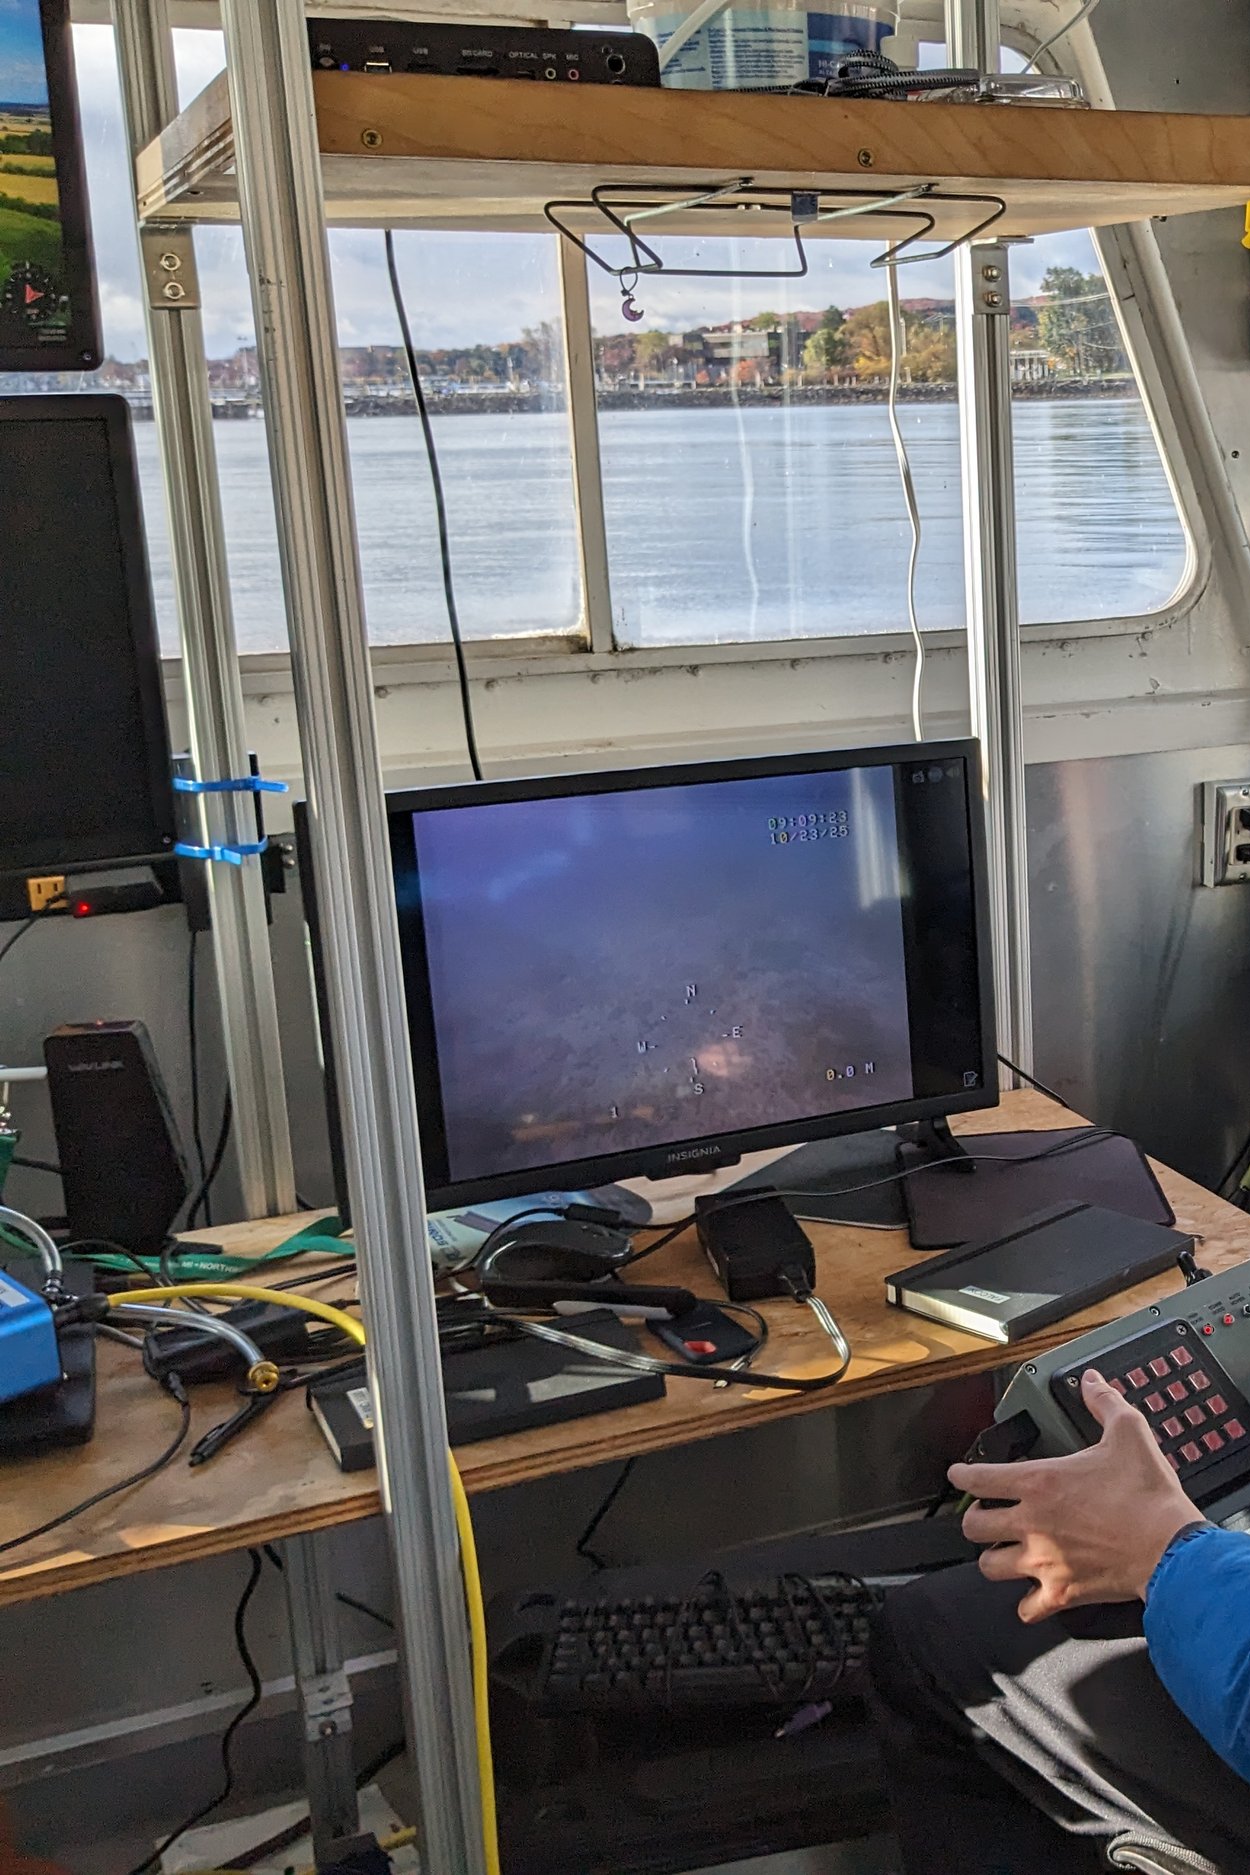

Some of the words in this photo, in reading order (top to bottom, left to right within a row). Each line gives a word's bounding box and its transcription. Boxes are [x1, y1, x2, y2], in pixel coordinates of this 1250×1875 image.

[508, 51, 539, 60] OPTICAL
[542, 52, 557, 60] SPK
[768, 810, 848, 831] 09:09:23
[770, 825, 849, 845] 10/23/25
[686, 984, 697, 997] N
[732, 1025, 743, 1039] E
[637, 1041, 649, 1054] W
[826, 1064, 855, 1081] 0.0
[864, 1061, 875, 1075] M
[693, 1083, 704, 1096] S
[666, 1145, 722, 1164] INSIGNIA
